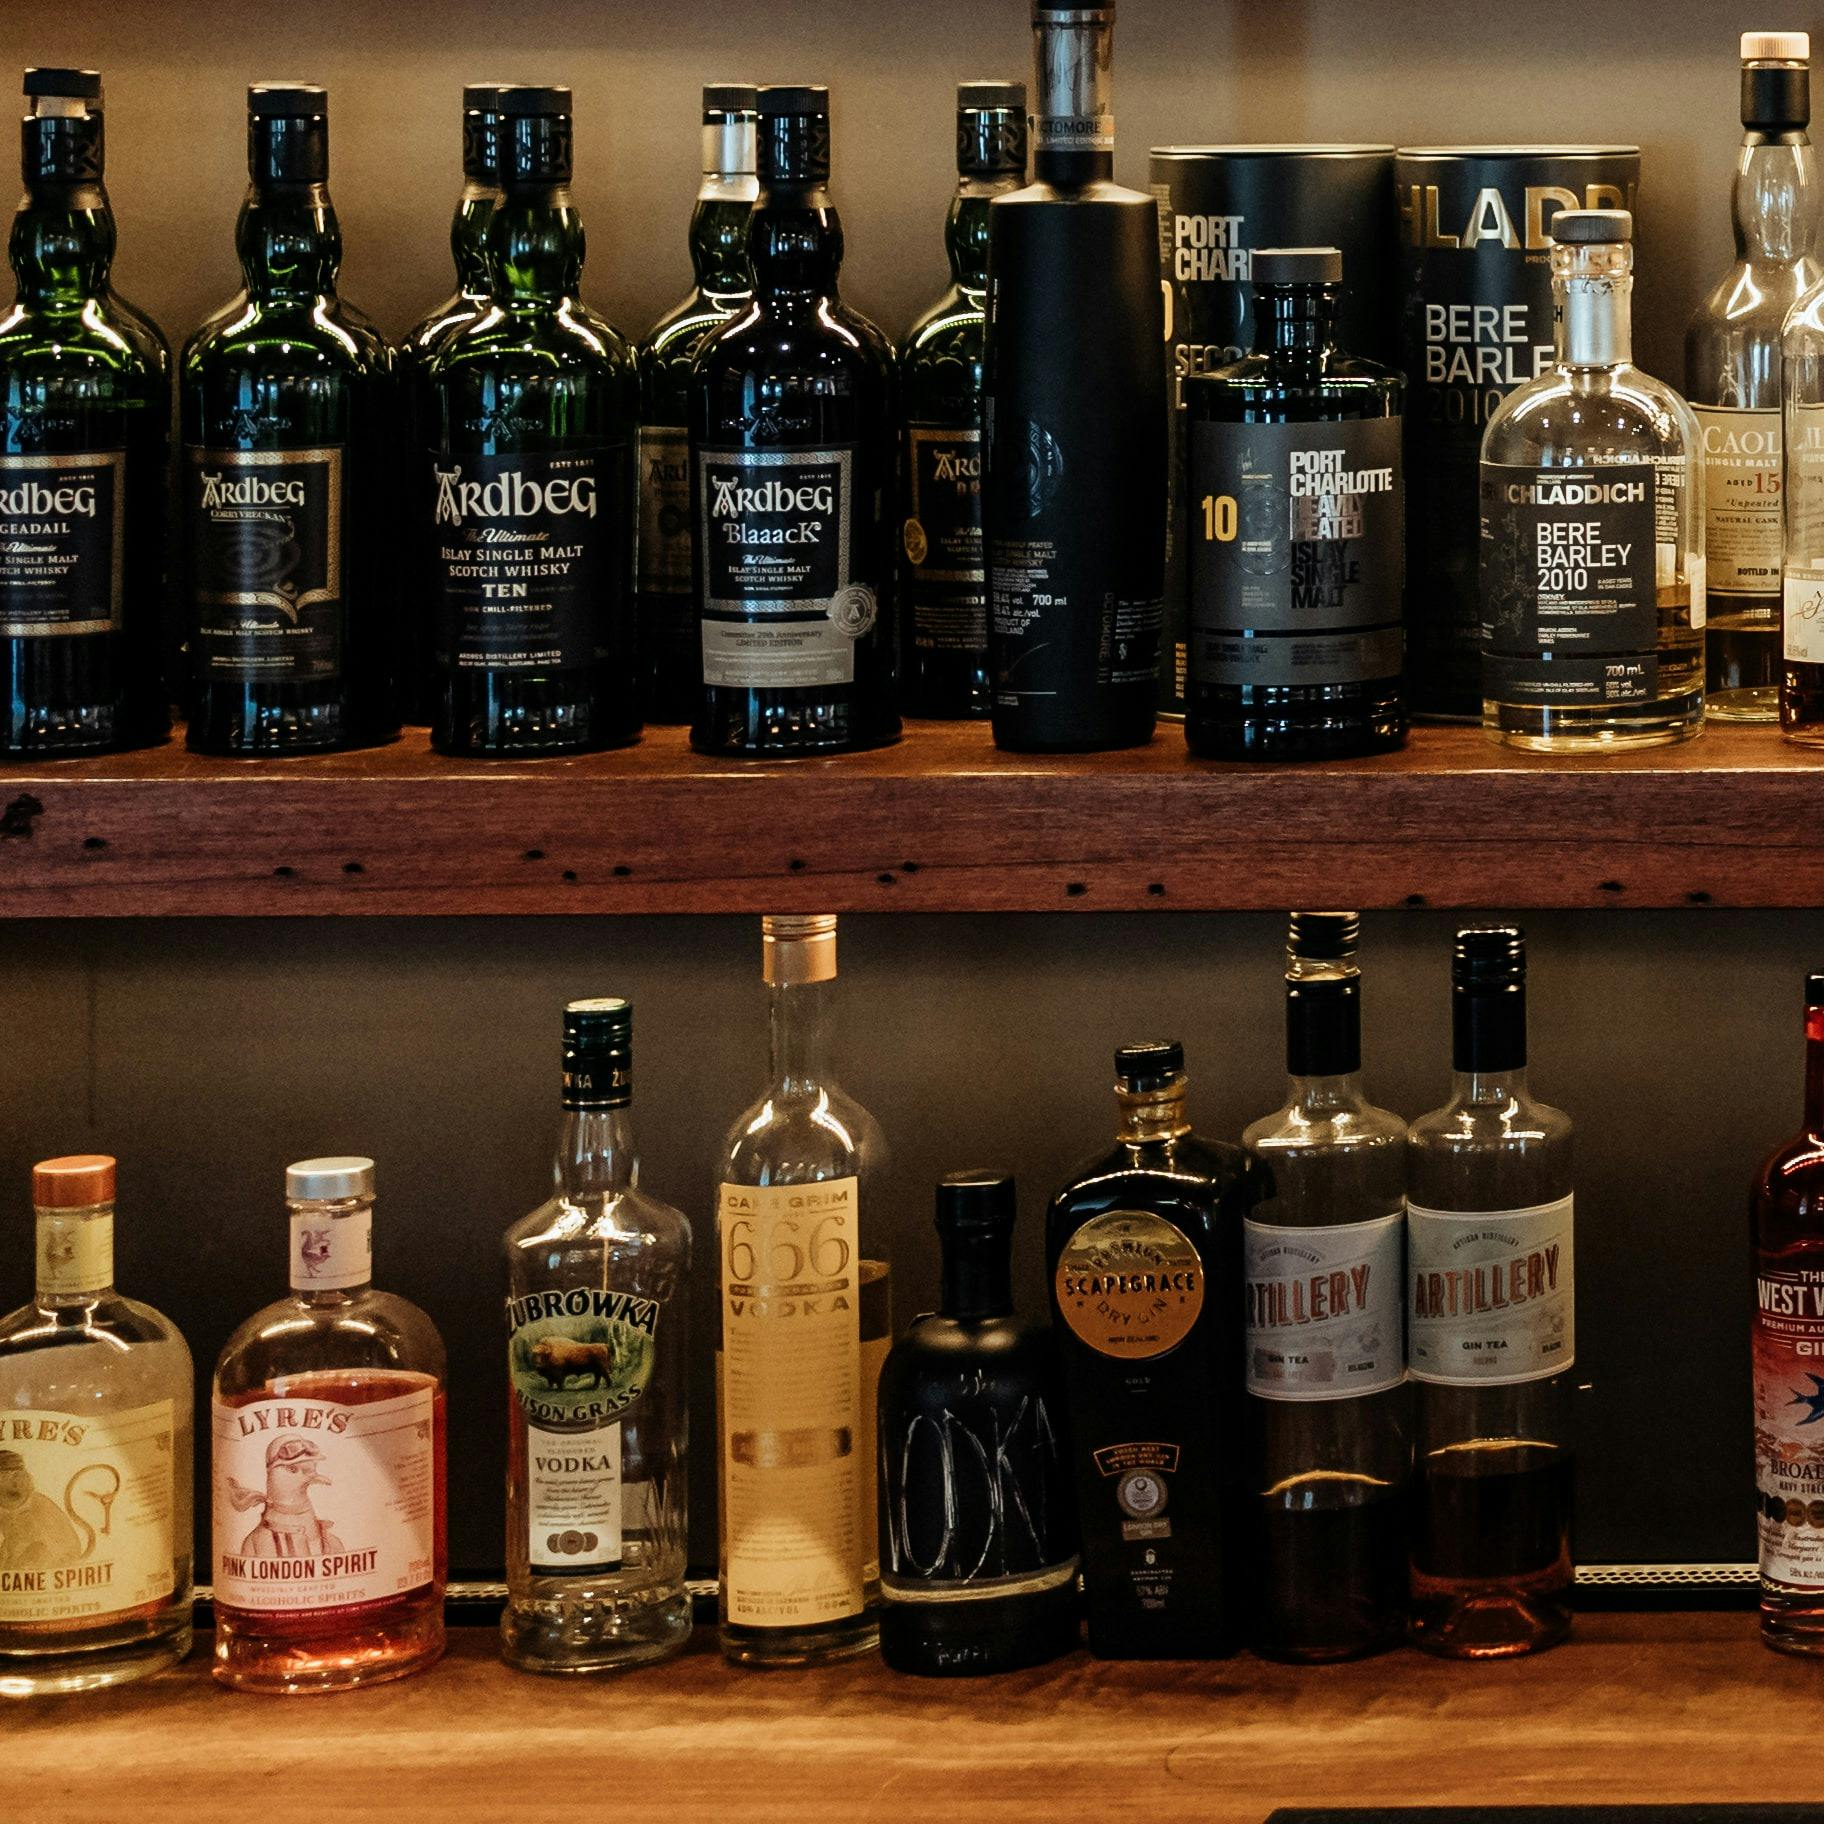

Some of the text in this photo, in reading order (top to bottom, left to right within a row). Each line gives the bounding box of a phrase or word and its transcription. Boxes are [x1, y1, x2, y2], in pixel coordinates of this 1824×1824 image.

[1425, 303, 1528, 345] BERE
[1290, 450, 1345, 474] PORT
[1290, 467, 1393, 497] CHARLOTTE
[1201, 496, 1237, 541] 10
[1537, 523, 1601, 545] BERE
[1537, 545, 1631, 568] BARLEY
[1537, 570, 1587, 590] 2010
[1066, 1272, 1195, 1296] SCAPEGRACE
[1415, 1244, 1560, 1320] ARTILLERY
[510, 1288, 660, 1337] UBRÓWKA
[1463, 1340, 1508, 1350] GIN TEA
[237, 1407, 351, 1437] LYRE'S
[536, 1454, 611, 1473] VODKA
[221, 1550, 378, 1580] PINK LONDON SPIRIT
